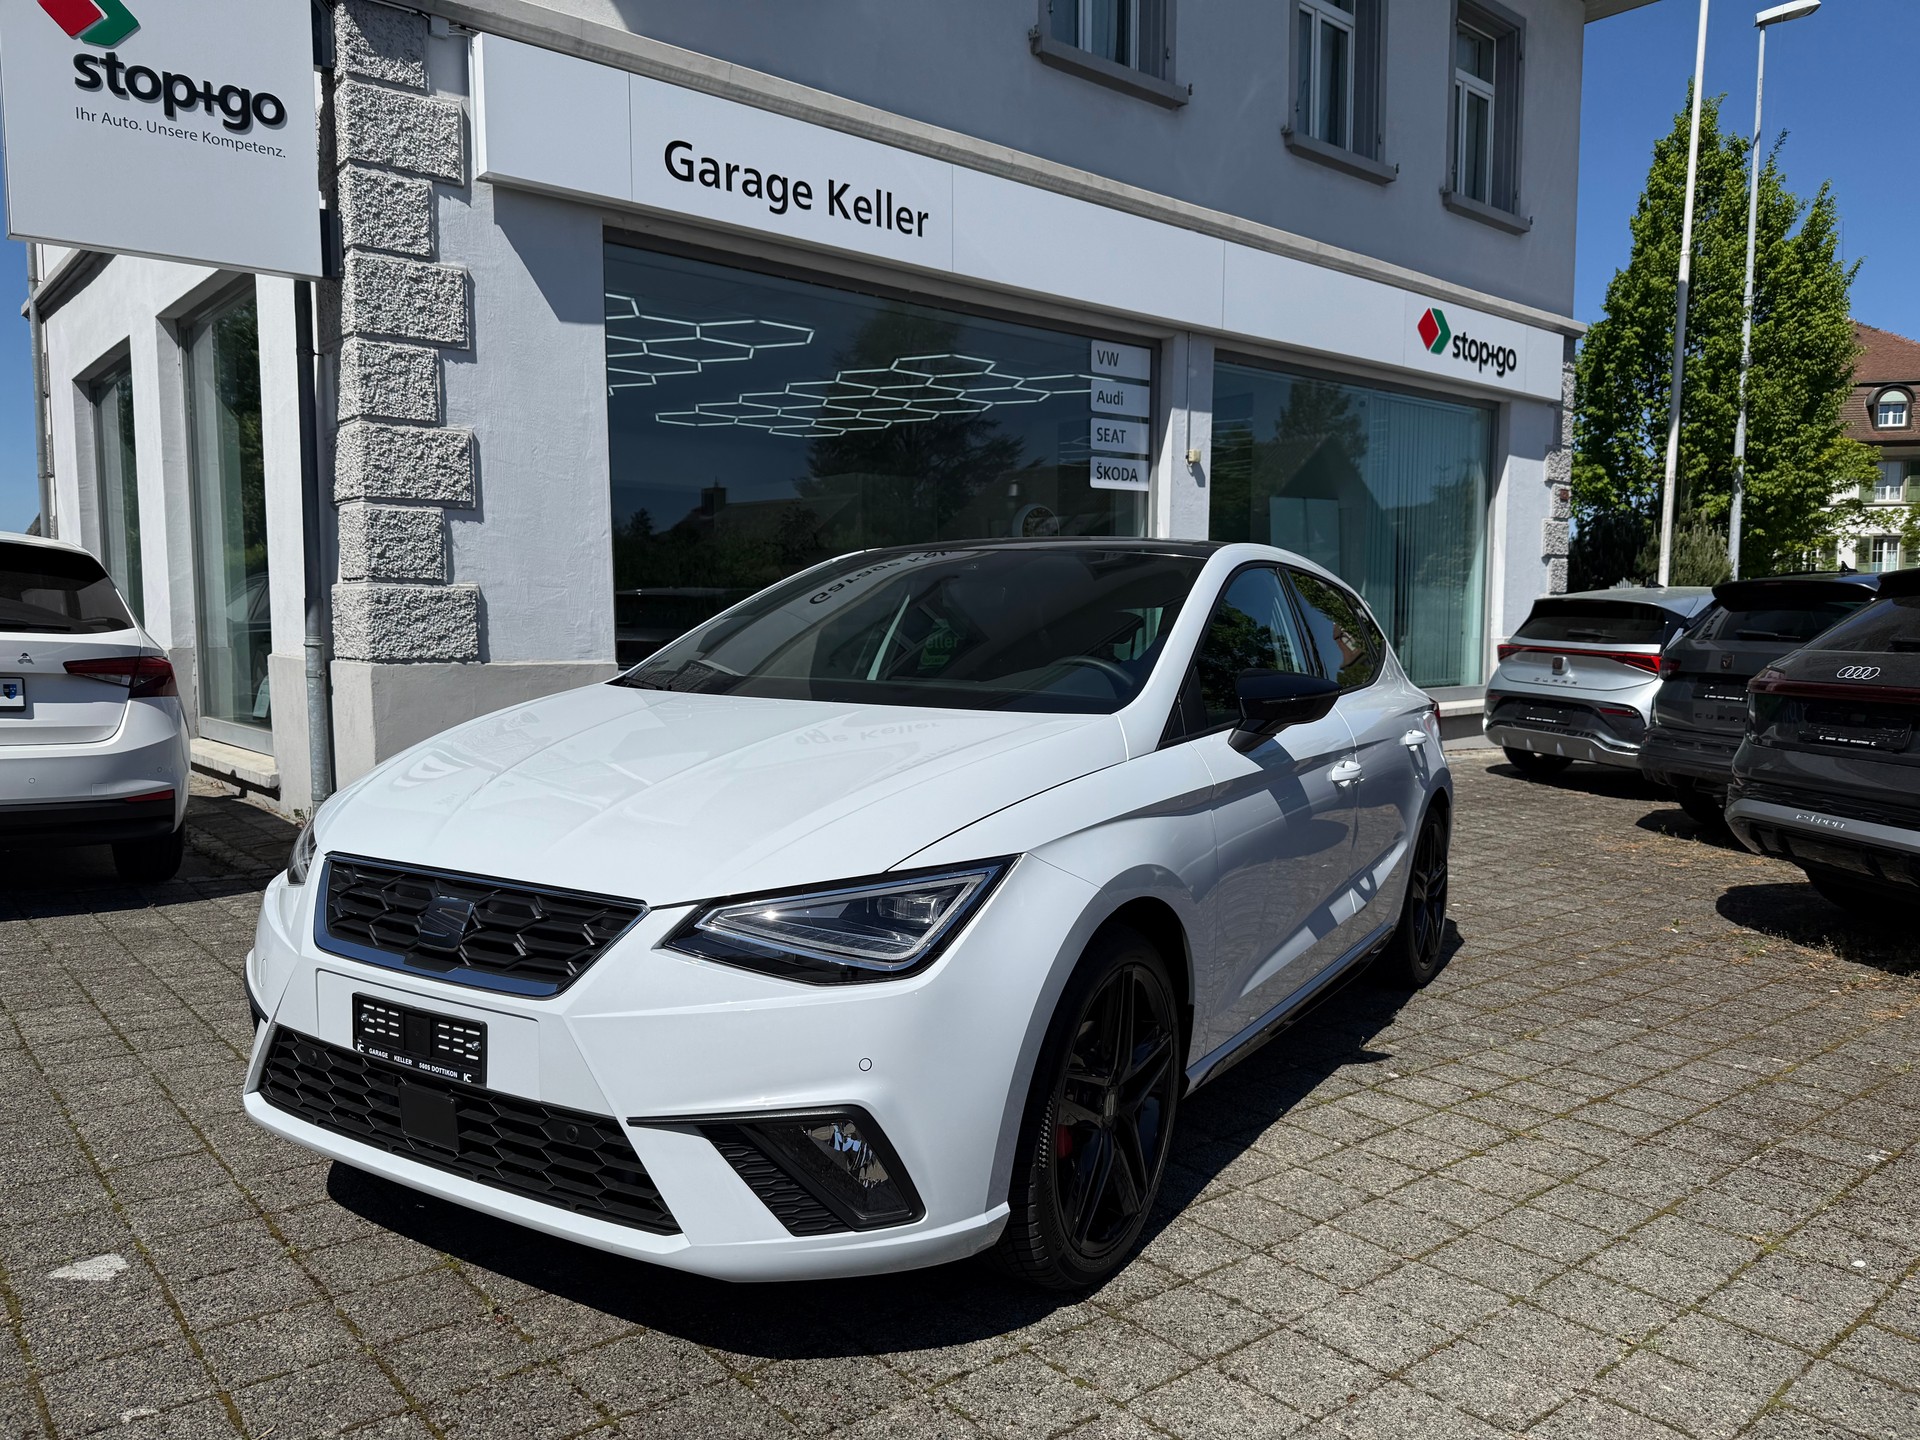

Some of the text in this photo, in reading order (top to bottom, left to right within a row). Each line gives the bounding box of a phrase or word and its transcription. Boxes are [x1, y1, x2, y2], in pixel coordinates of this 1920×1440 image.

[73, 51, 286, 132] stop+go
[75, 106, 286, 158] Ihr Auto. Unsere Kompetenz.
[664, 140, 929, 238] Garage Keller
[1096, 349, 1119, 367] VW
[1452, 331, 1517, 378] stop+go
[1096, 390, 1124, 406] Audi
[1096, 427, 1126, 444] SEAT
[1096, 462, 1139, 482] ŠKODA
[368, 1047, 389, 1059] GARAGE
[393, 1054, 412, 1066] KELLER
[431, 1065, 458, 1078] DOTTIKON
